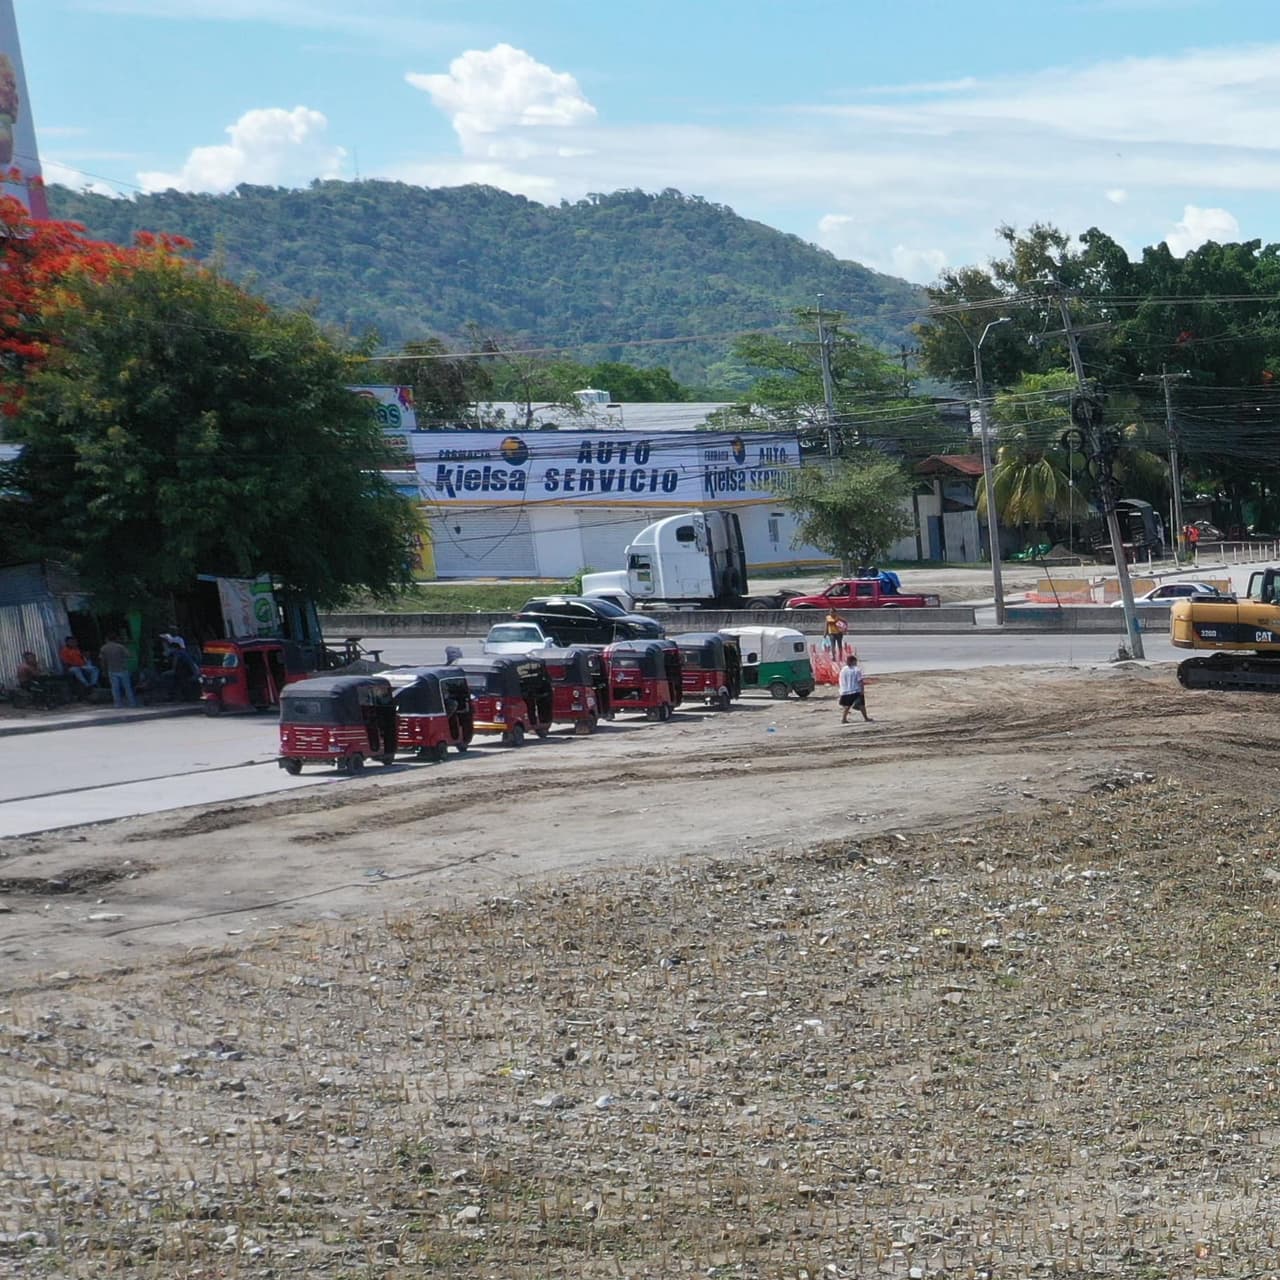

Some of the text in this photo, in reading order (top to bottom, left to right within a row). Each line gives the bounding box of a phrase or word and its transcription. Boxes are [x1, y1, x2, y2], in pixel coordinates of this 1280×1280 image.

[577, 440, 650, 465] AUTO
[759, 447, 787, 464] AUTO
[544, 468, 679, 493] SERVICIO
[1255, 631, 1273, 642] CAT
